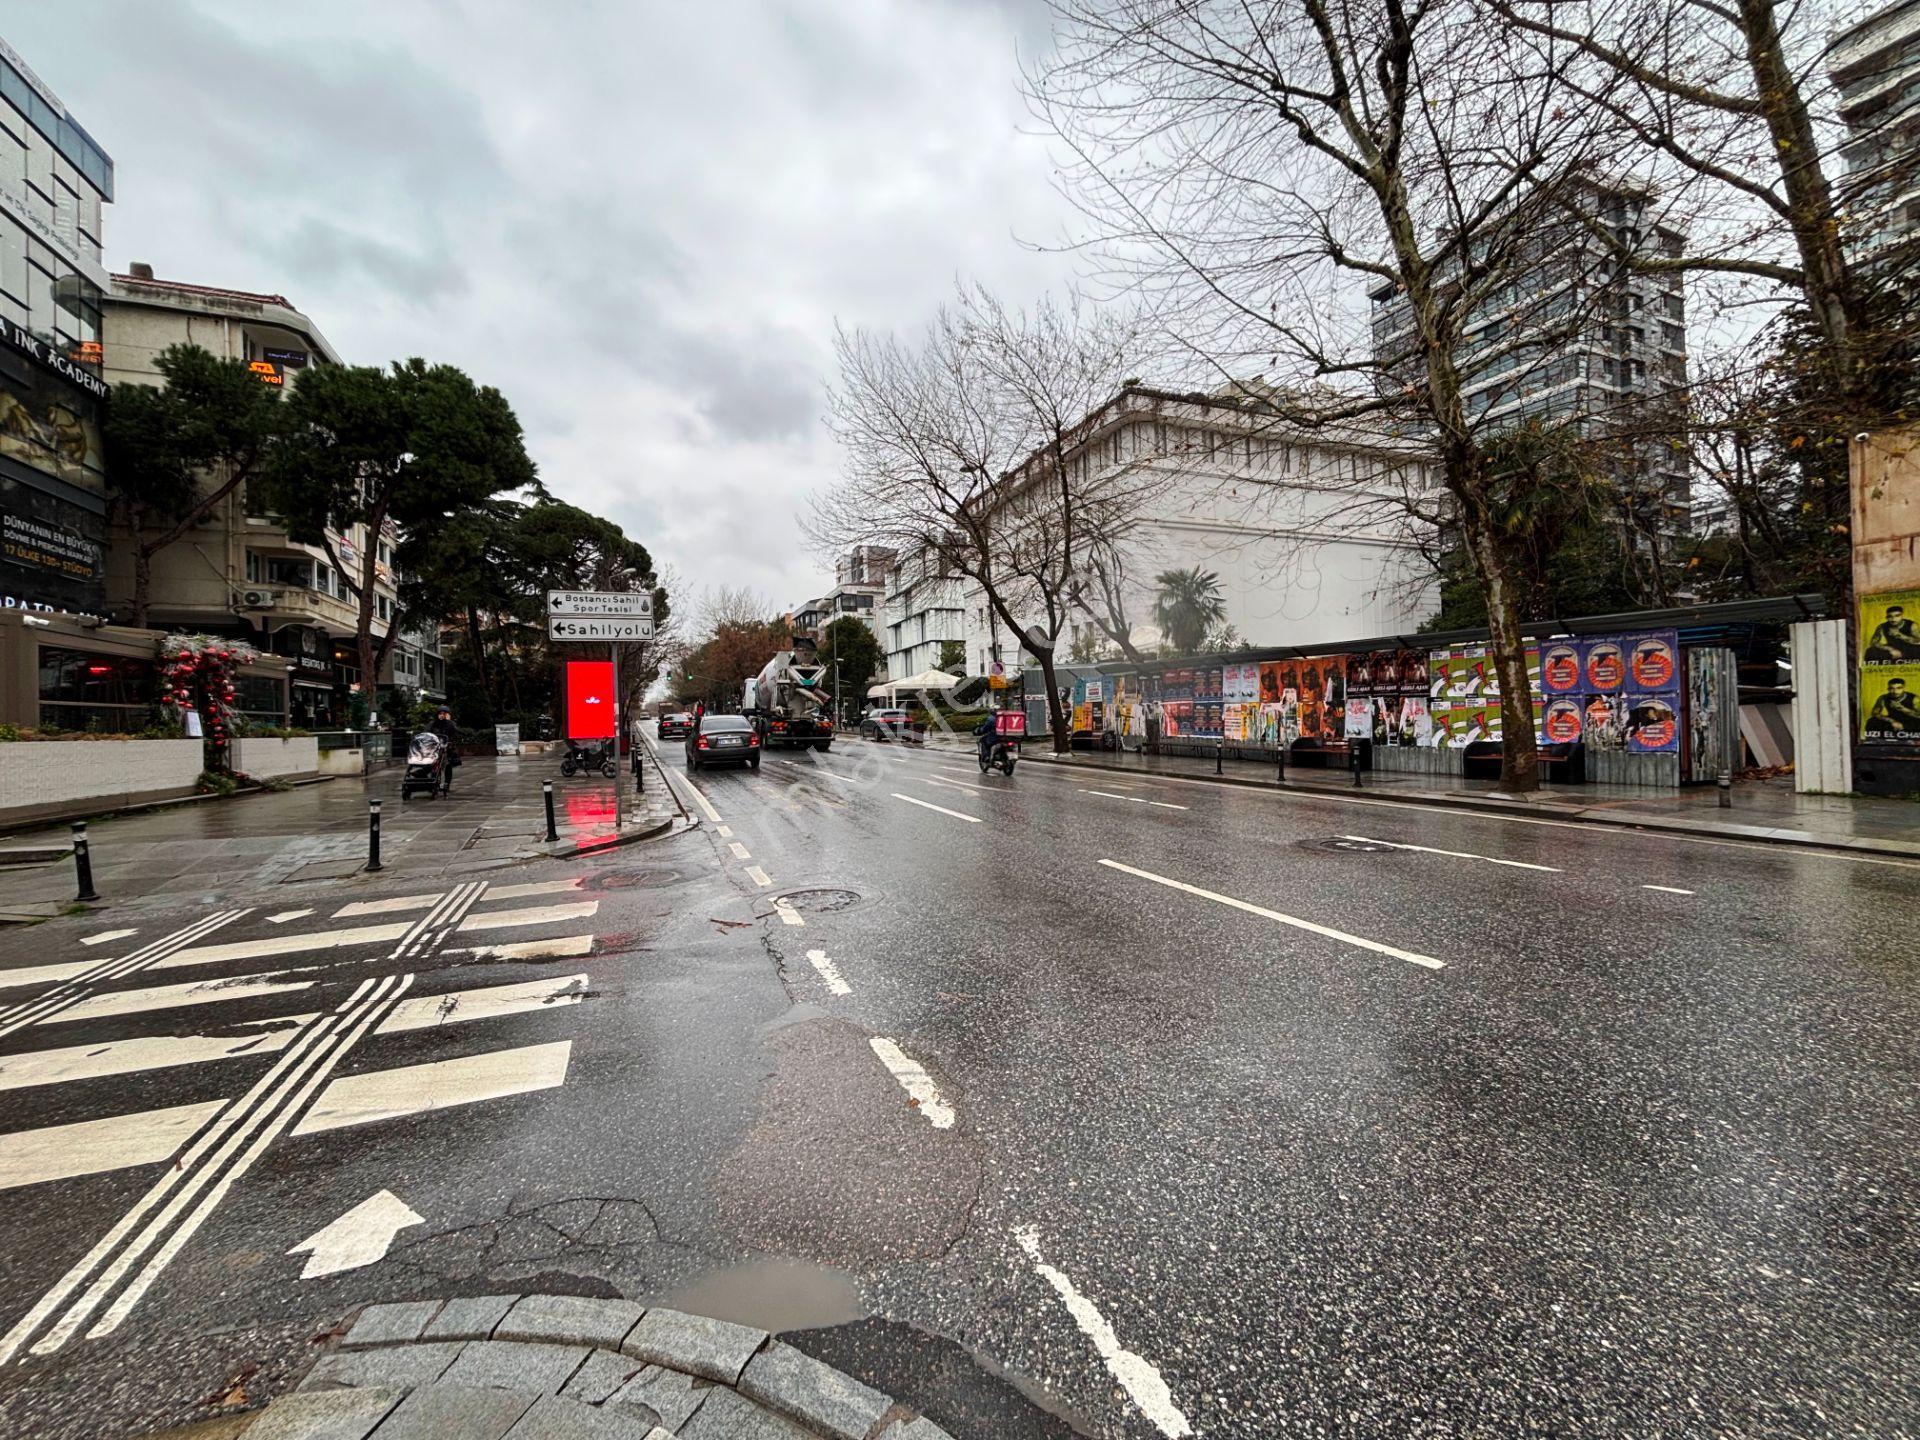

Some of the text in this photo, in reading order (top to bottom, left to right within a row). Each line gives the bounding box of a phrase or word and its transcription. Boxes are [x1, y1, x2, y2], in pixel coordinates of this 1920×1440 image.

[14, 328, 41, 360] INK
[3, 515, 52, 539] DÜNYANIN
[52, 533, 65, 544] EN
[17, 545, 40, 562] ÜLKE
[565, 594, 639, 604] Bostancı Sahil
[573, 605, 632, 613] Spor Tesisi
[567, 623, 650, 637] Sahilyolu
